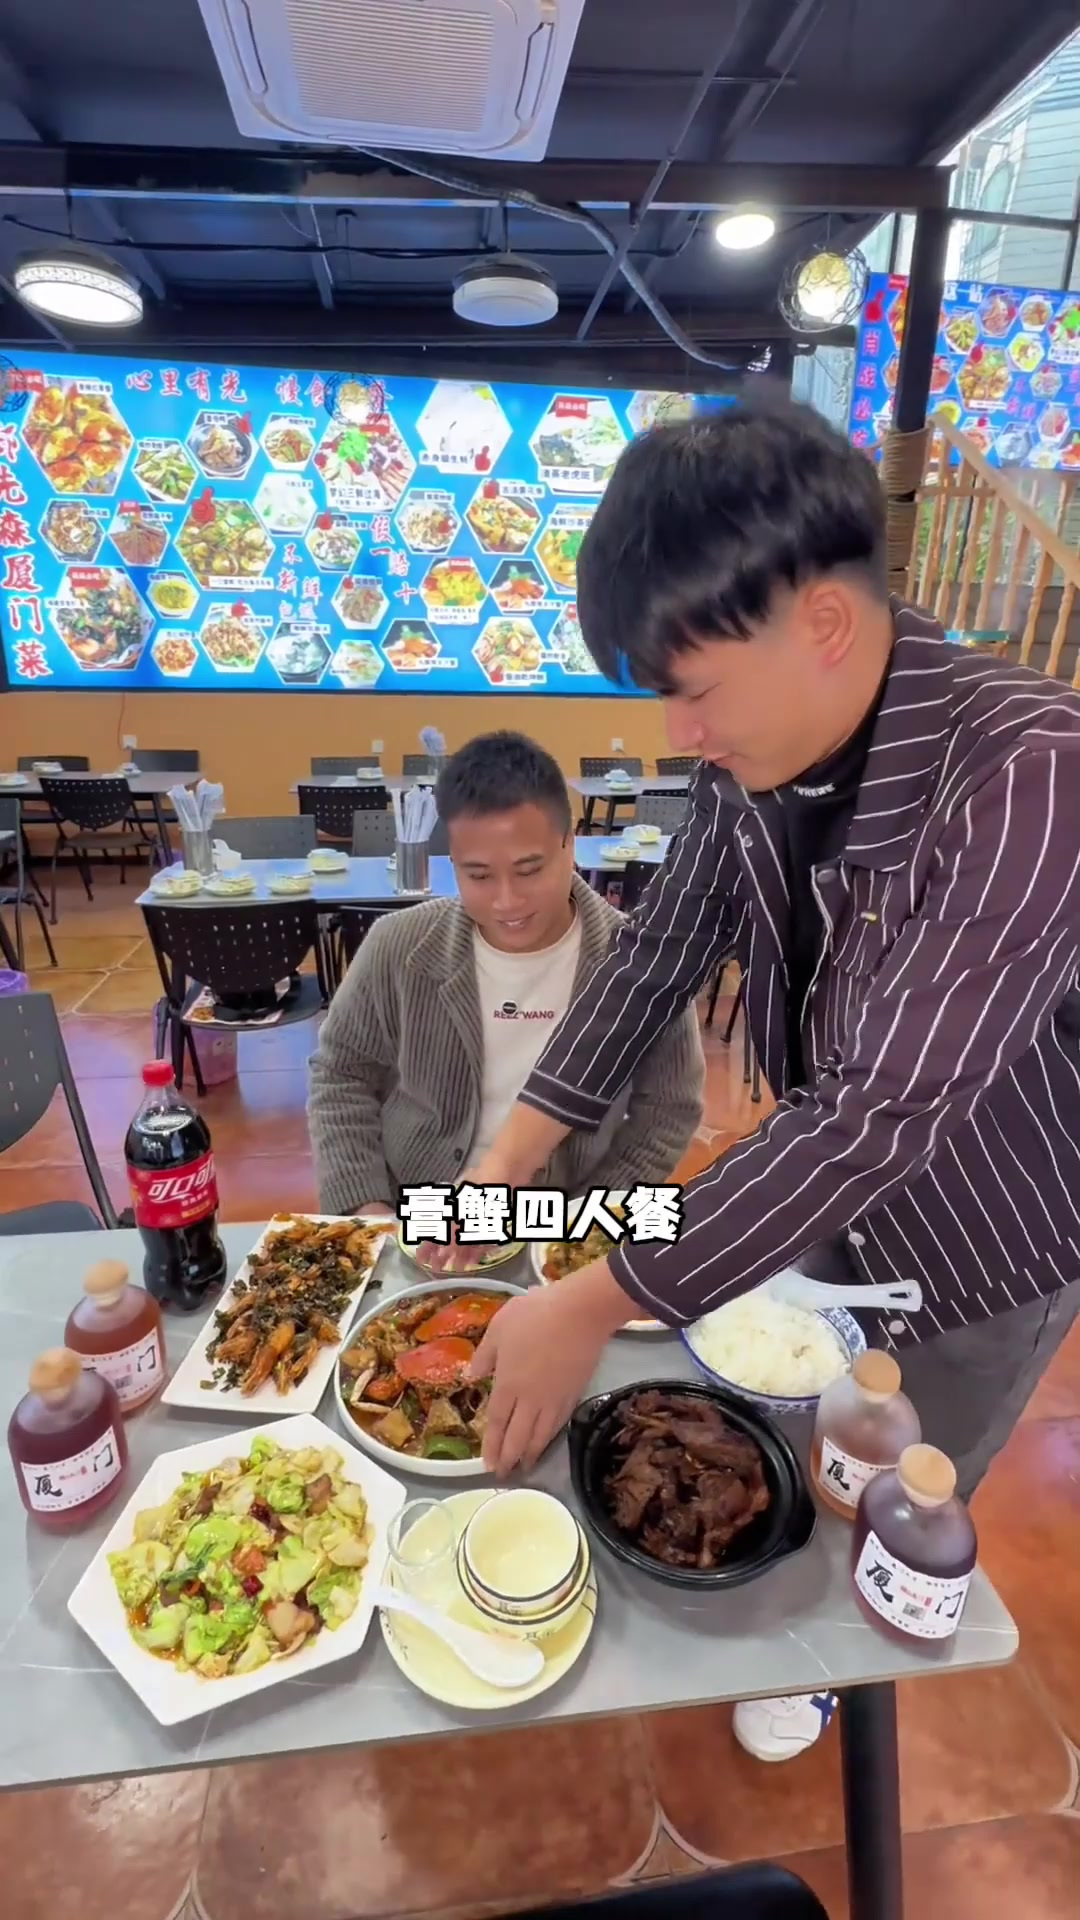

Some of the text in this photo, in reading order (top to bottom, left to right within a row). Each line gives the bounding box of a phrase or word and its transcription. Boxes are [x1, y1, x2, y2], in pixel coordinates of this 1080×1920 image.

[126, 369, 248, 403] 心里有光
[147, 1153, 216, 1204] 可口可
